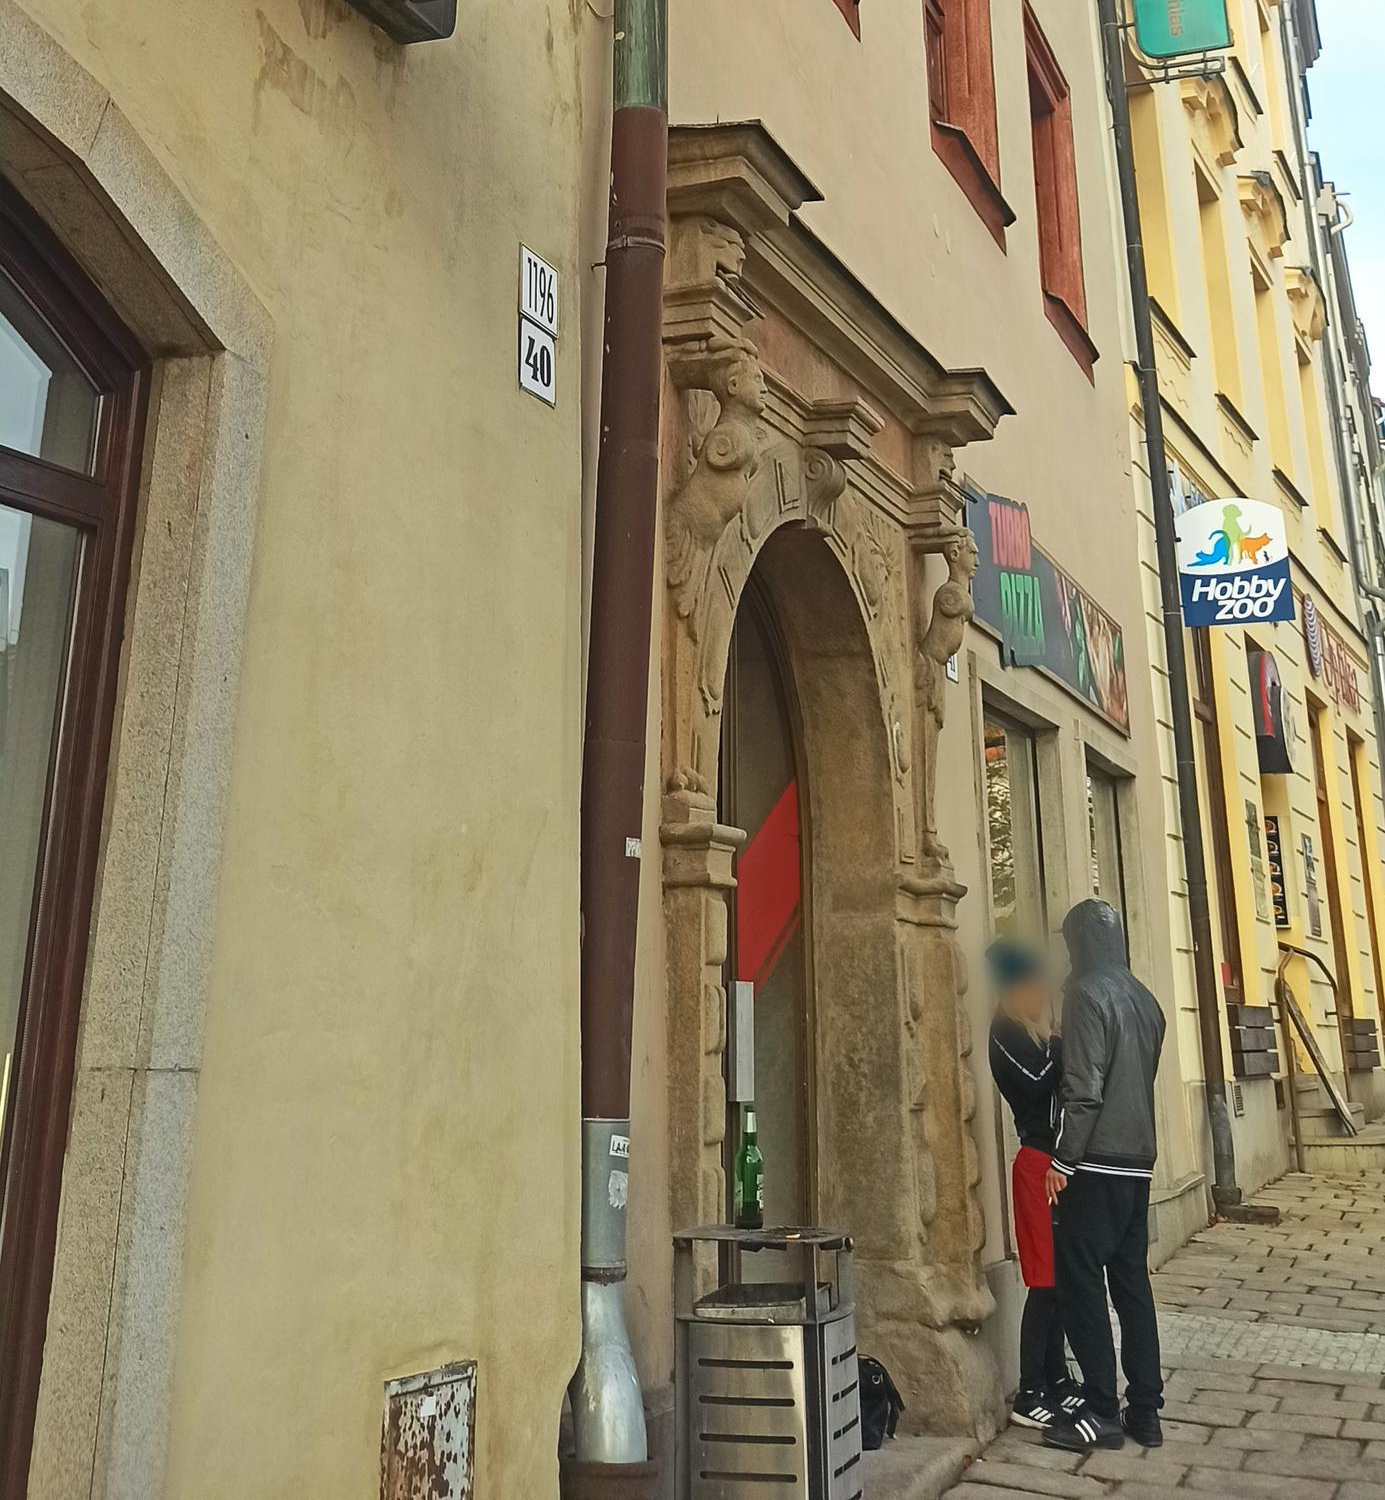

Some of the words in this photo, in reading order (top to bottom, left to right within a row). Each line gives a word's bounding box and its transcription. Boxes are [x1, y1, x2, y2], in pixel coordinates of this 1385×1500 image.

[527, 257, 554, 325] 1196
[524, 335, 552, 388] 40
[989, 503, 1031, 569] TURBO
[1001, 572, 1045, 654] PIZZA
[1192, 575, 1286, 602] Hobby
